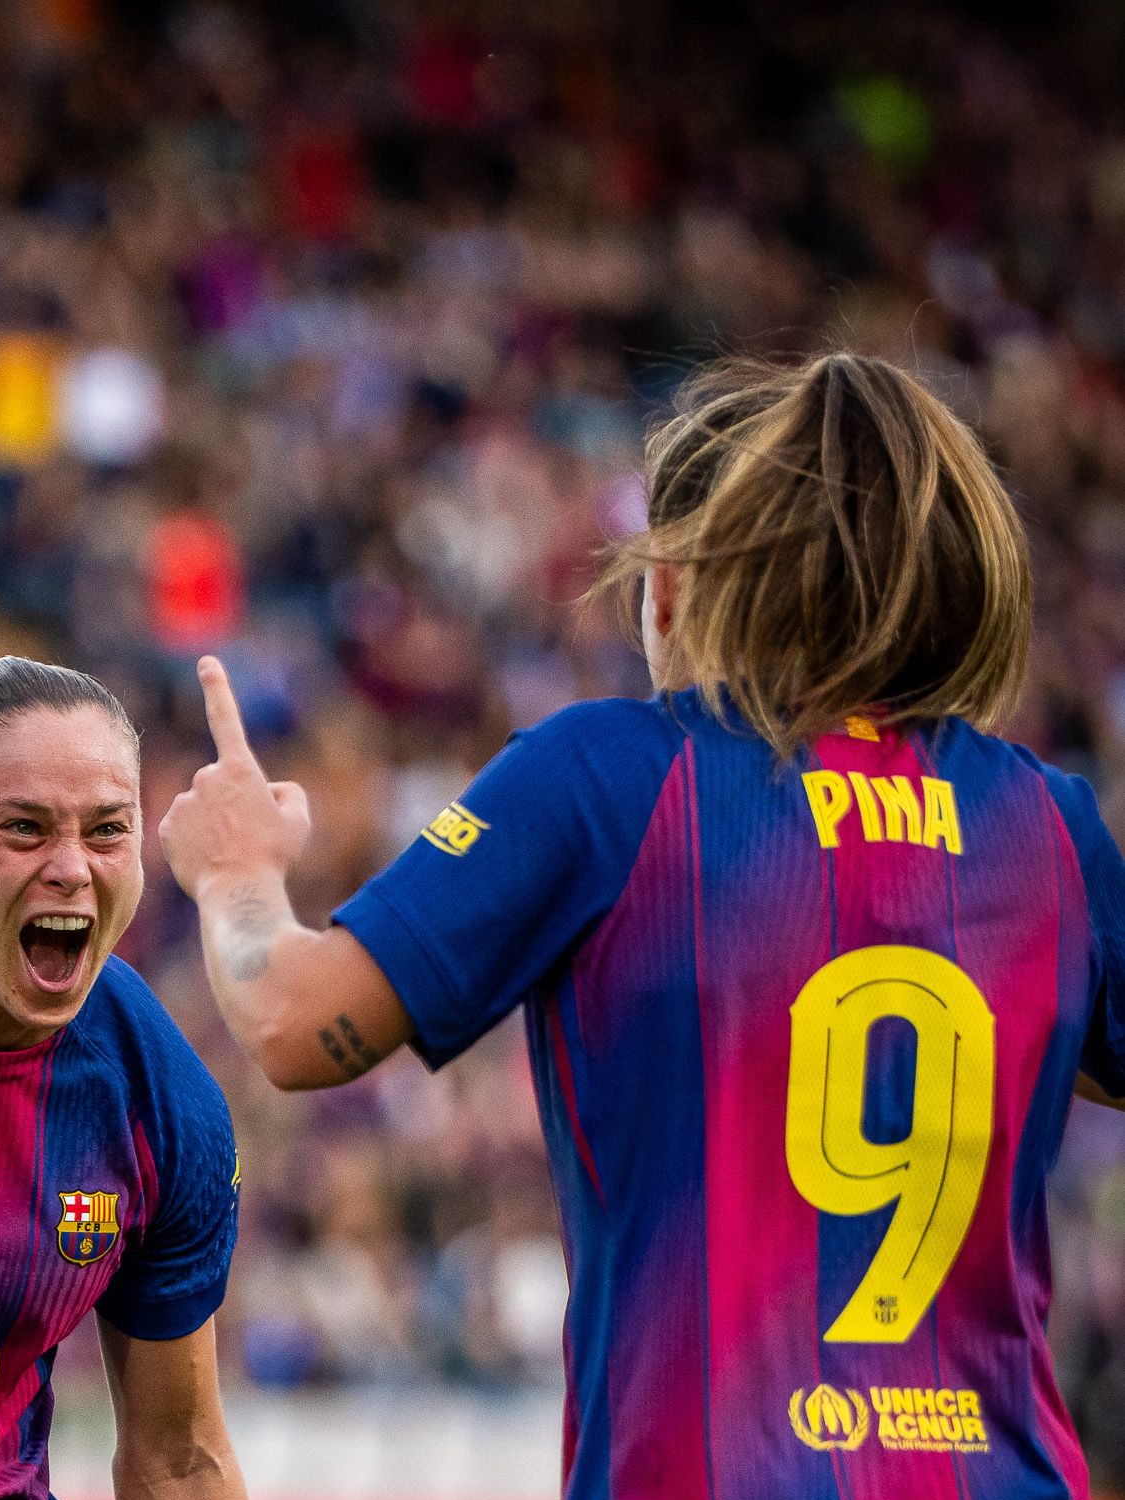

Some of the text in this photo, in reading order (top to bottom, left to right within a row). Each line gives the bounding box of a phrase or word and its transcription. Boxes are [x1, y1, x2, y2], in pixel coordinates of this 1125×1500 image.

[801, 769, 964, 855] PINA
[785, 944, 996, 1344] 9
[869, 1386, 980, 1416] UNHCR
[878, 1413, 987, 1441] ACNUR
